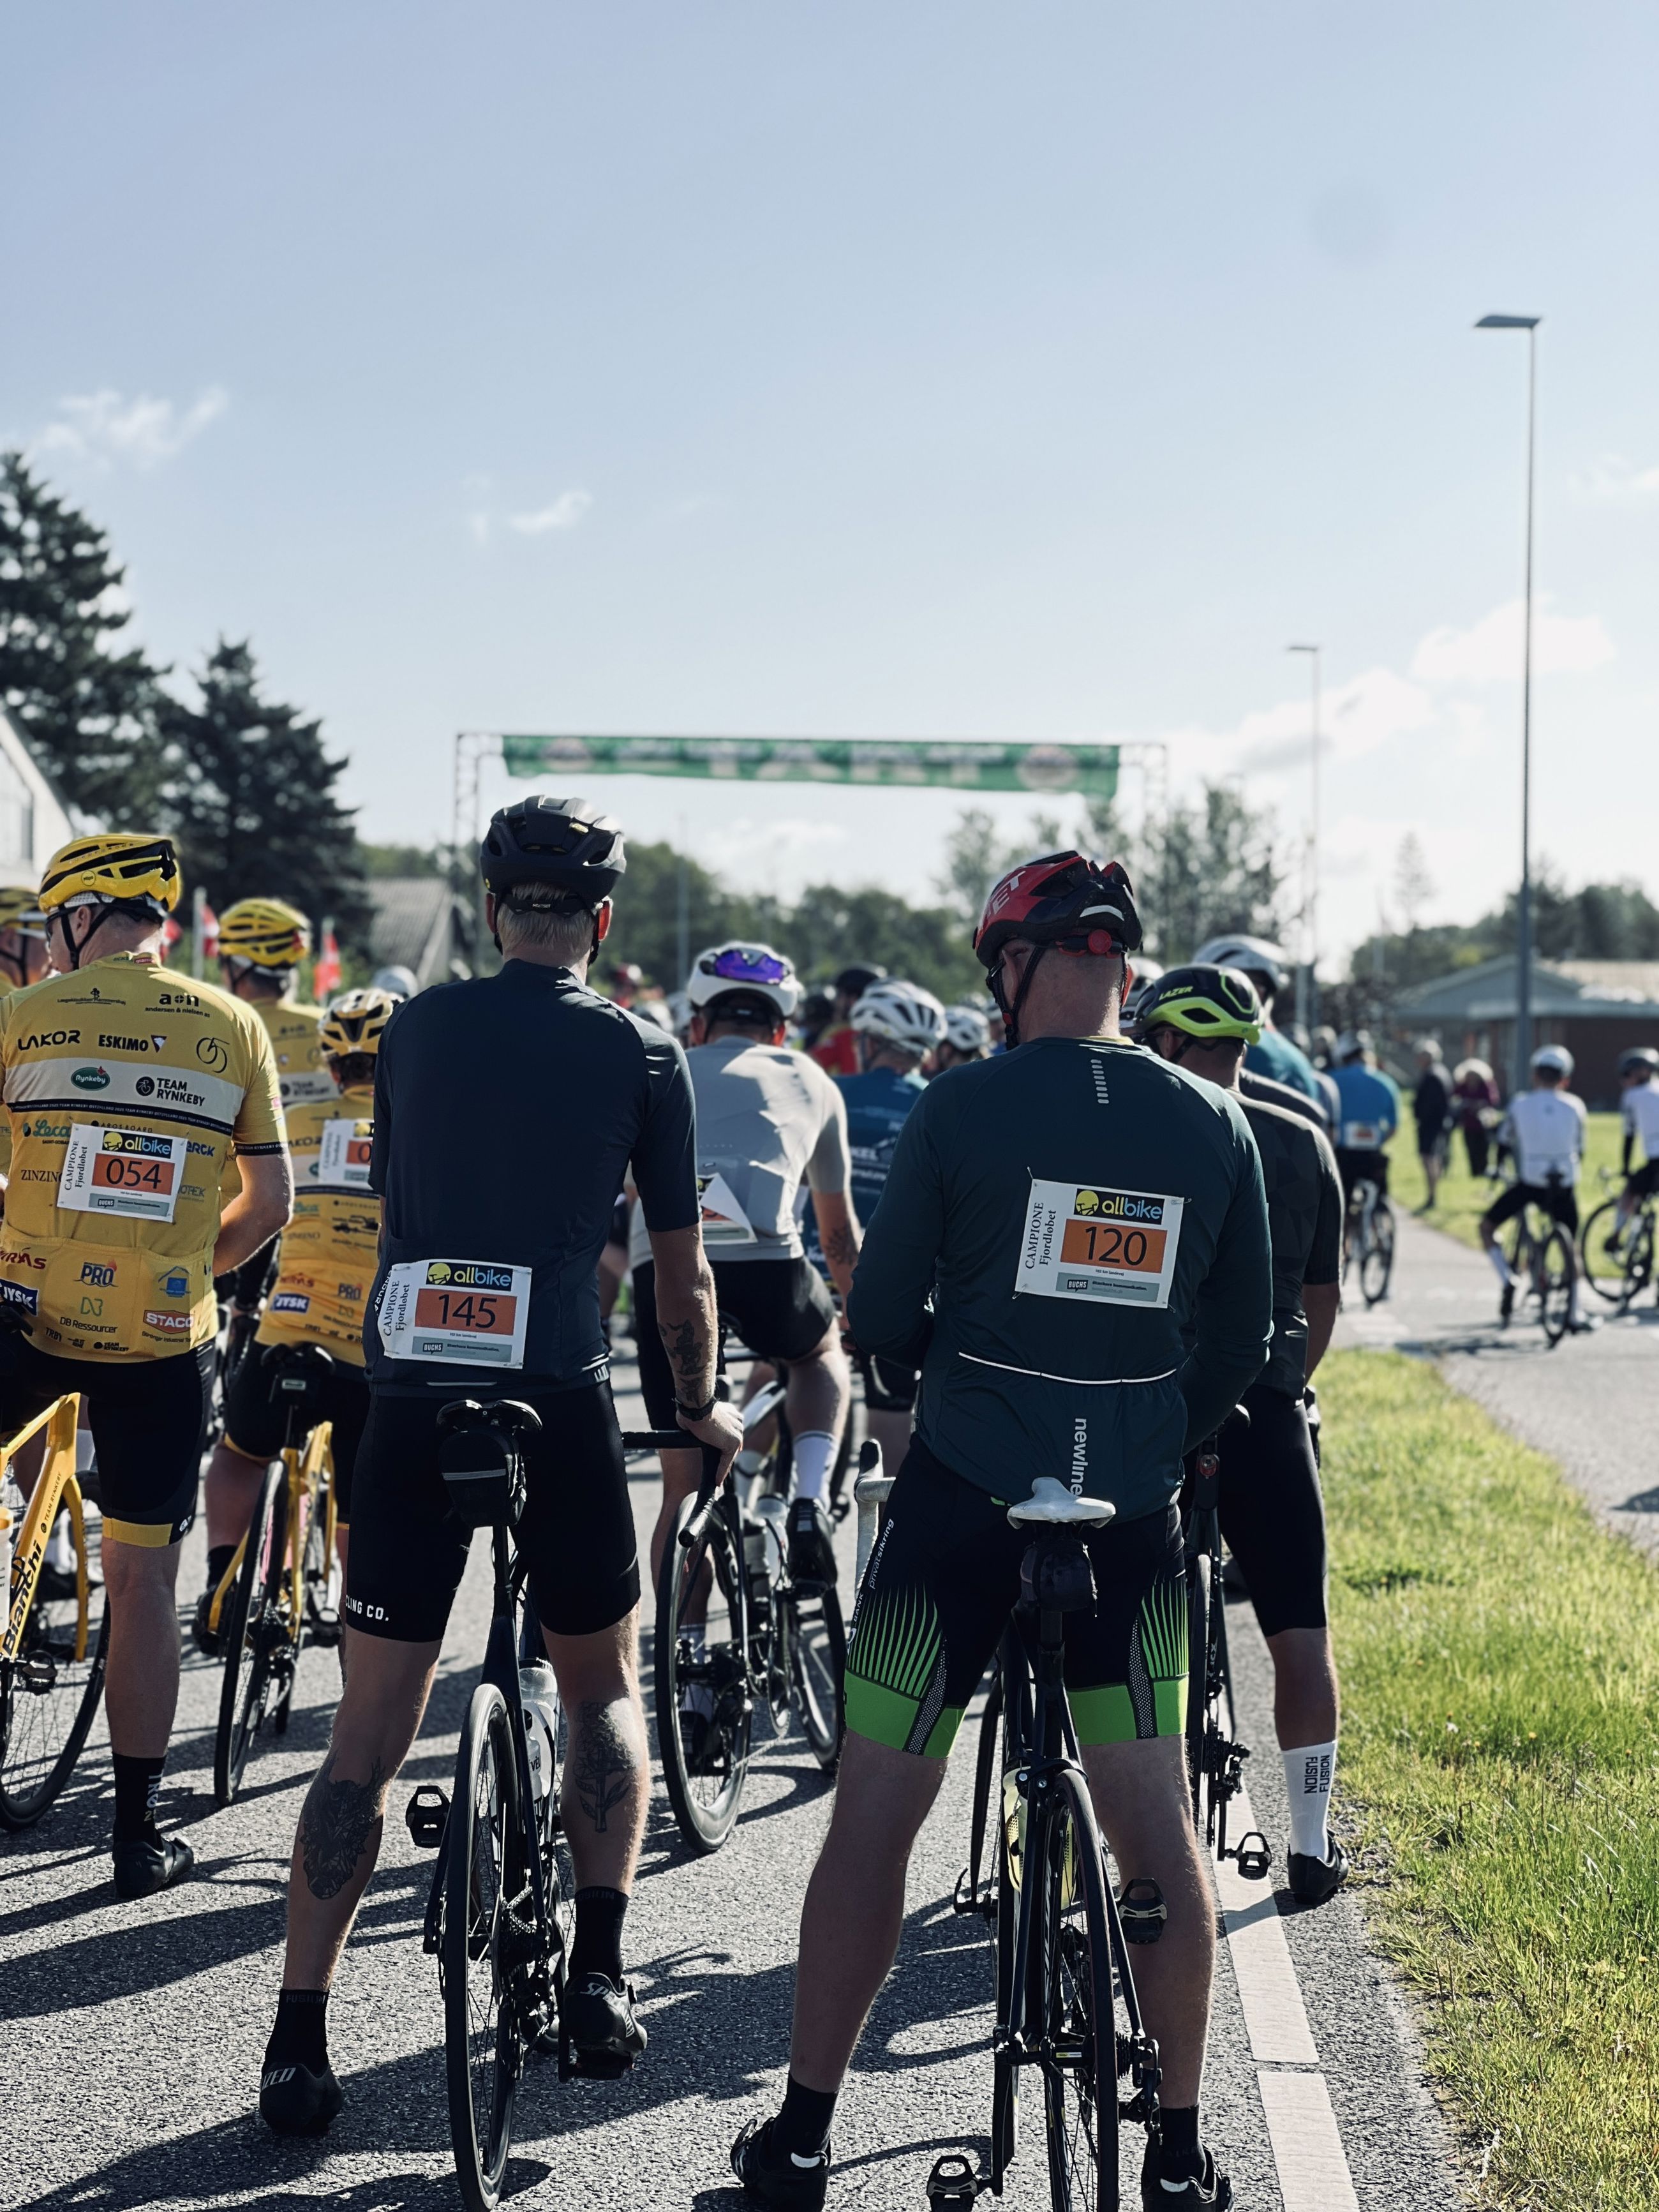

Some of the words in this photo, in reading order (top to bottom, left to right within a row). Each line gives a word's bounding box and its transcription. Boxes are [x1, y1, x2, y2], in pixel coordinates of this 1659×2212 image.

[1159, 986, 1193, 1001] LAZER
[18, 1029, 80, 1050] LAKOR
[98, 1034, 149, 1052] ESKIMO
[75, 1074, 106, 1084] Rynkeby
[157, 1077, 187, 1091] TEAM
[156, 1089, 205, 1107] RYNKEBY
[124, 1137, 171, 1155] allbike
[64, 1140, 80, 1191] CAMPIONE
[106, 1158, 162, 1190] 054
[1101, 1196, 1163, 1220] allbike
[1025, 1202, 1045, 1269] CAMPIONE
[1039, 1209, 1057, 1266] Fjordløbet
[1085, 1226, 1147, 1266] 120
[81, 1265, 114, 1285] PRO
[454, 1267, 511, 1287] allbike
[1068, 1280, 1087, 1289] BUCHS
[4, 1286, 33, 1308] JYSK
[276, 1296, 308, 1308] JYSK
[374, 1271, 392, 1313] NDURA
[383, 1280, 400, 1336] CAMPIONE
[395, 1284, 410, 1331] Fjordløbet
[438, 1294, 498, 1329] 145
[60, 1317, 71, 1326] DB
[72, 1320, 118, 1333] Ressourcer
[424, 1343, 442, 1352] BUCHS
[1070, 1417, 1089, 1497] newline
[51, 1472, 62, 1502] RYNKEBY
[869, 1518, 895, 1590] privatsikring
[2, 1539, 42, 1656] Bianchi
[366, 1604, 389, 1621] CO.
[1304, 1756, 1318, 1794] FUSION
[1320, 1754, 1330, 1793] FUSION
